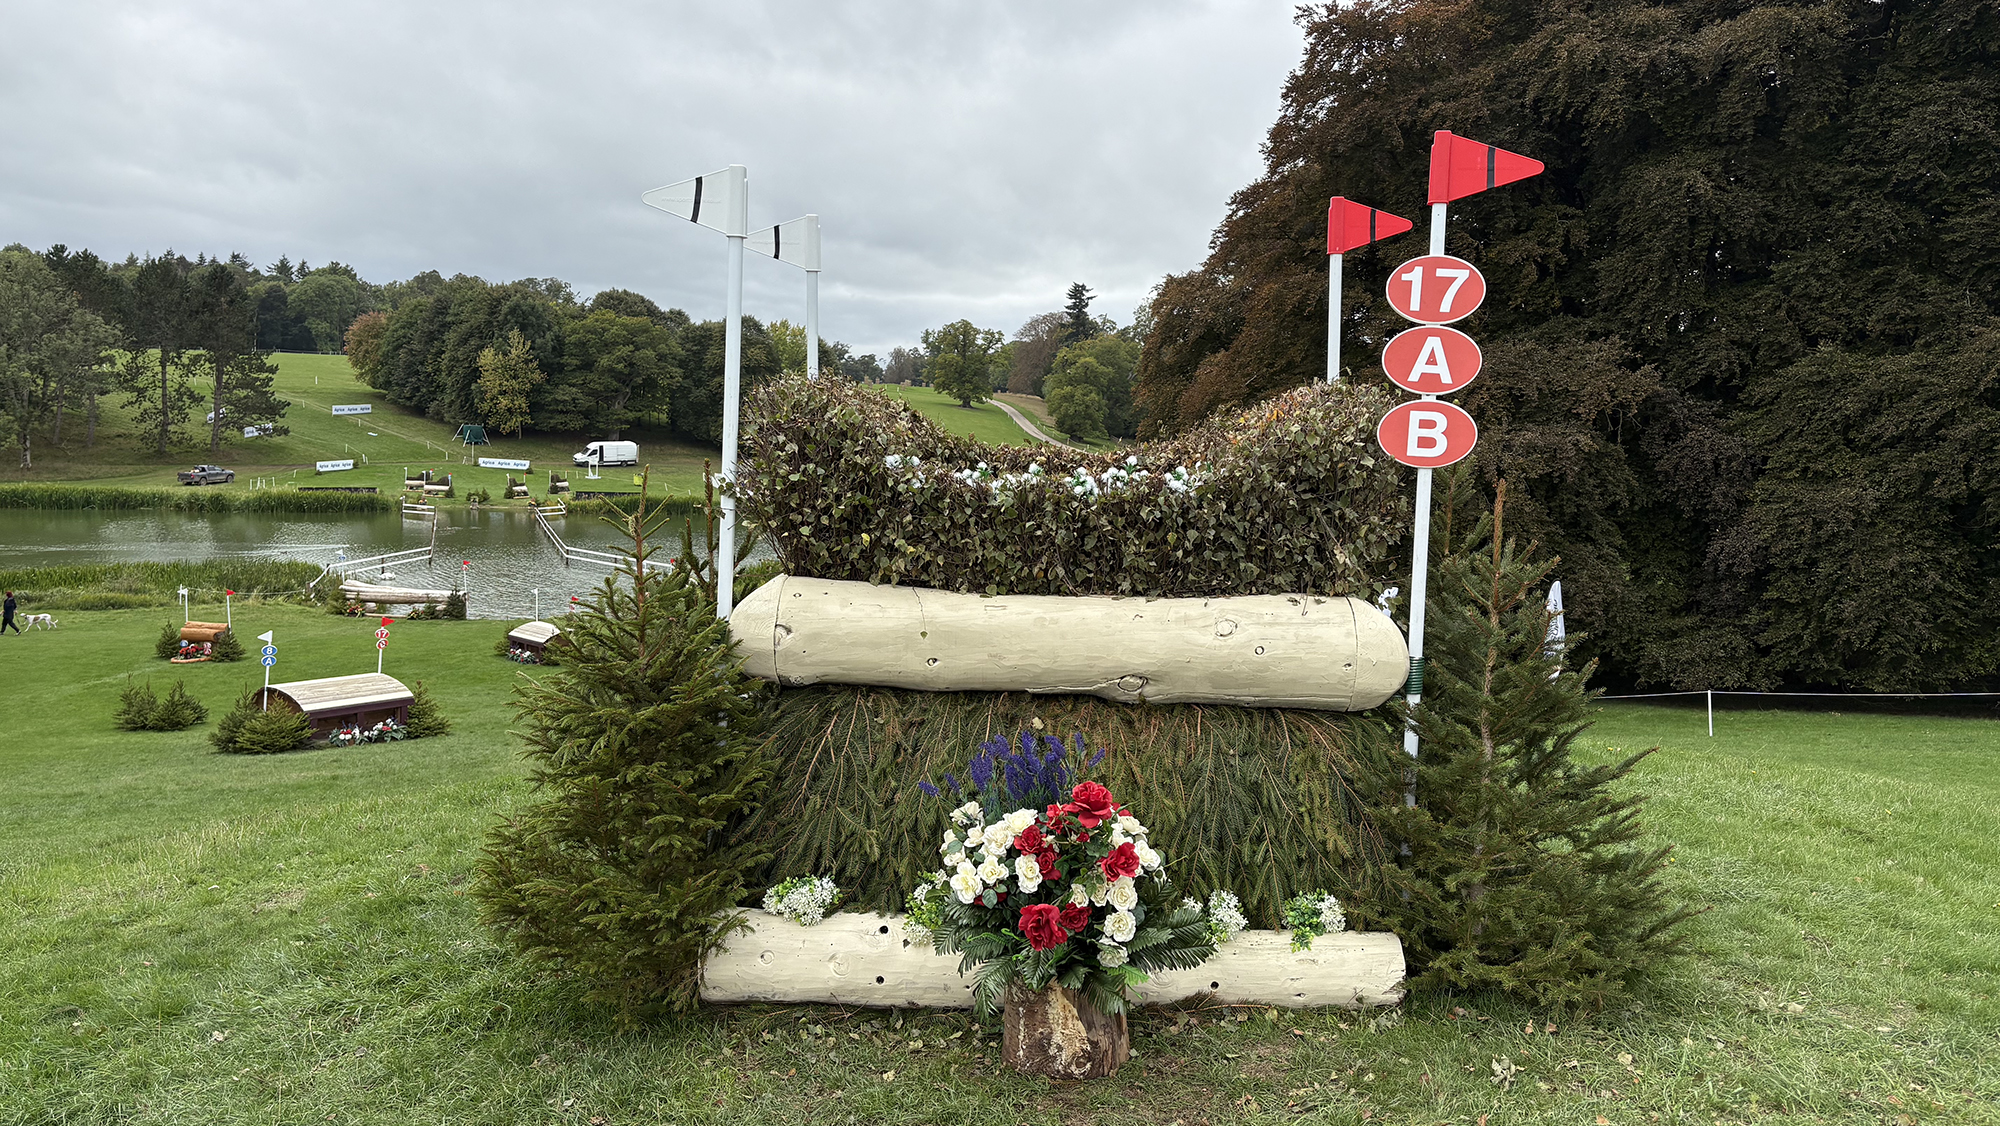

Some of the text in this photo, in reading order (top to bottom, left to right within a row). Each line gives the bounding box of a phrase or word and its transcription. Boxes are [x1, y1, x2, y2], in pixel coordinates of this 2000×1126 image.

[1401, 266, 1470, 313] 17
[1407, 336, 1453, 384] A
[1406, 411, 1448, 458] B
[377, 630, 388, 638] 17
[264, 657, 273, 666] A
[266, 647, 273, 655] 8
